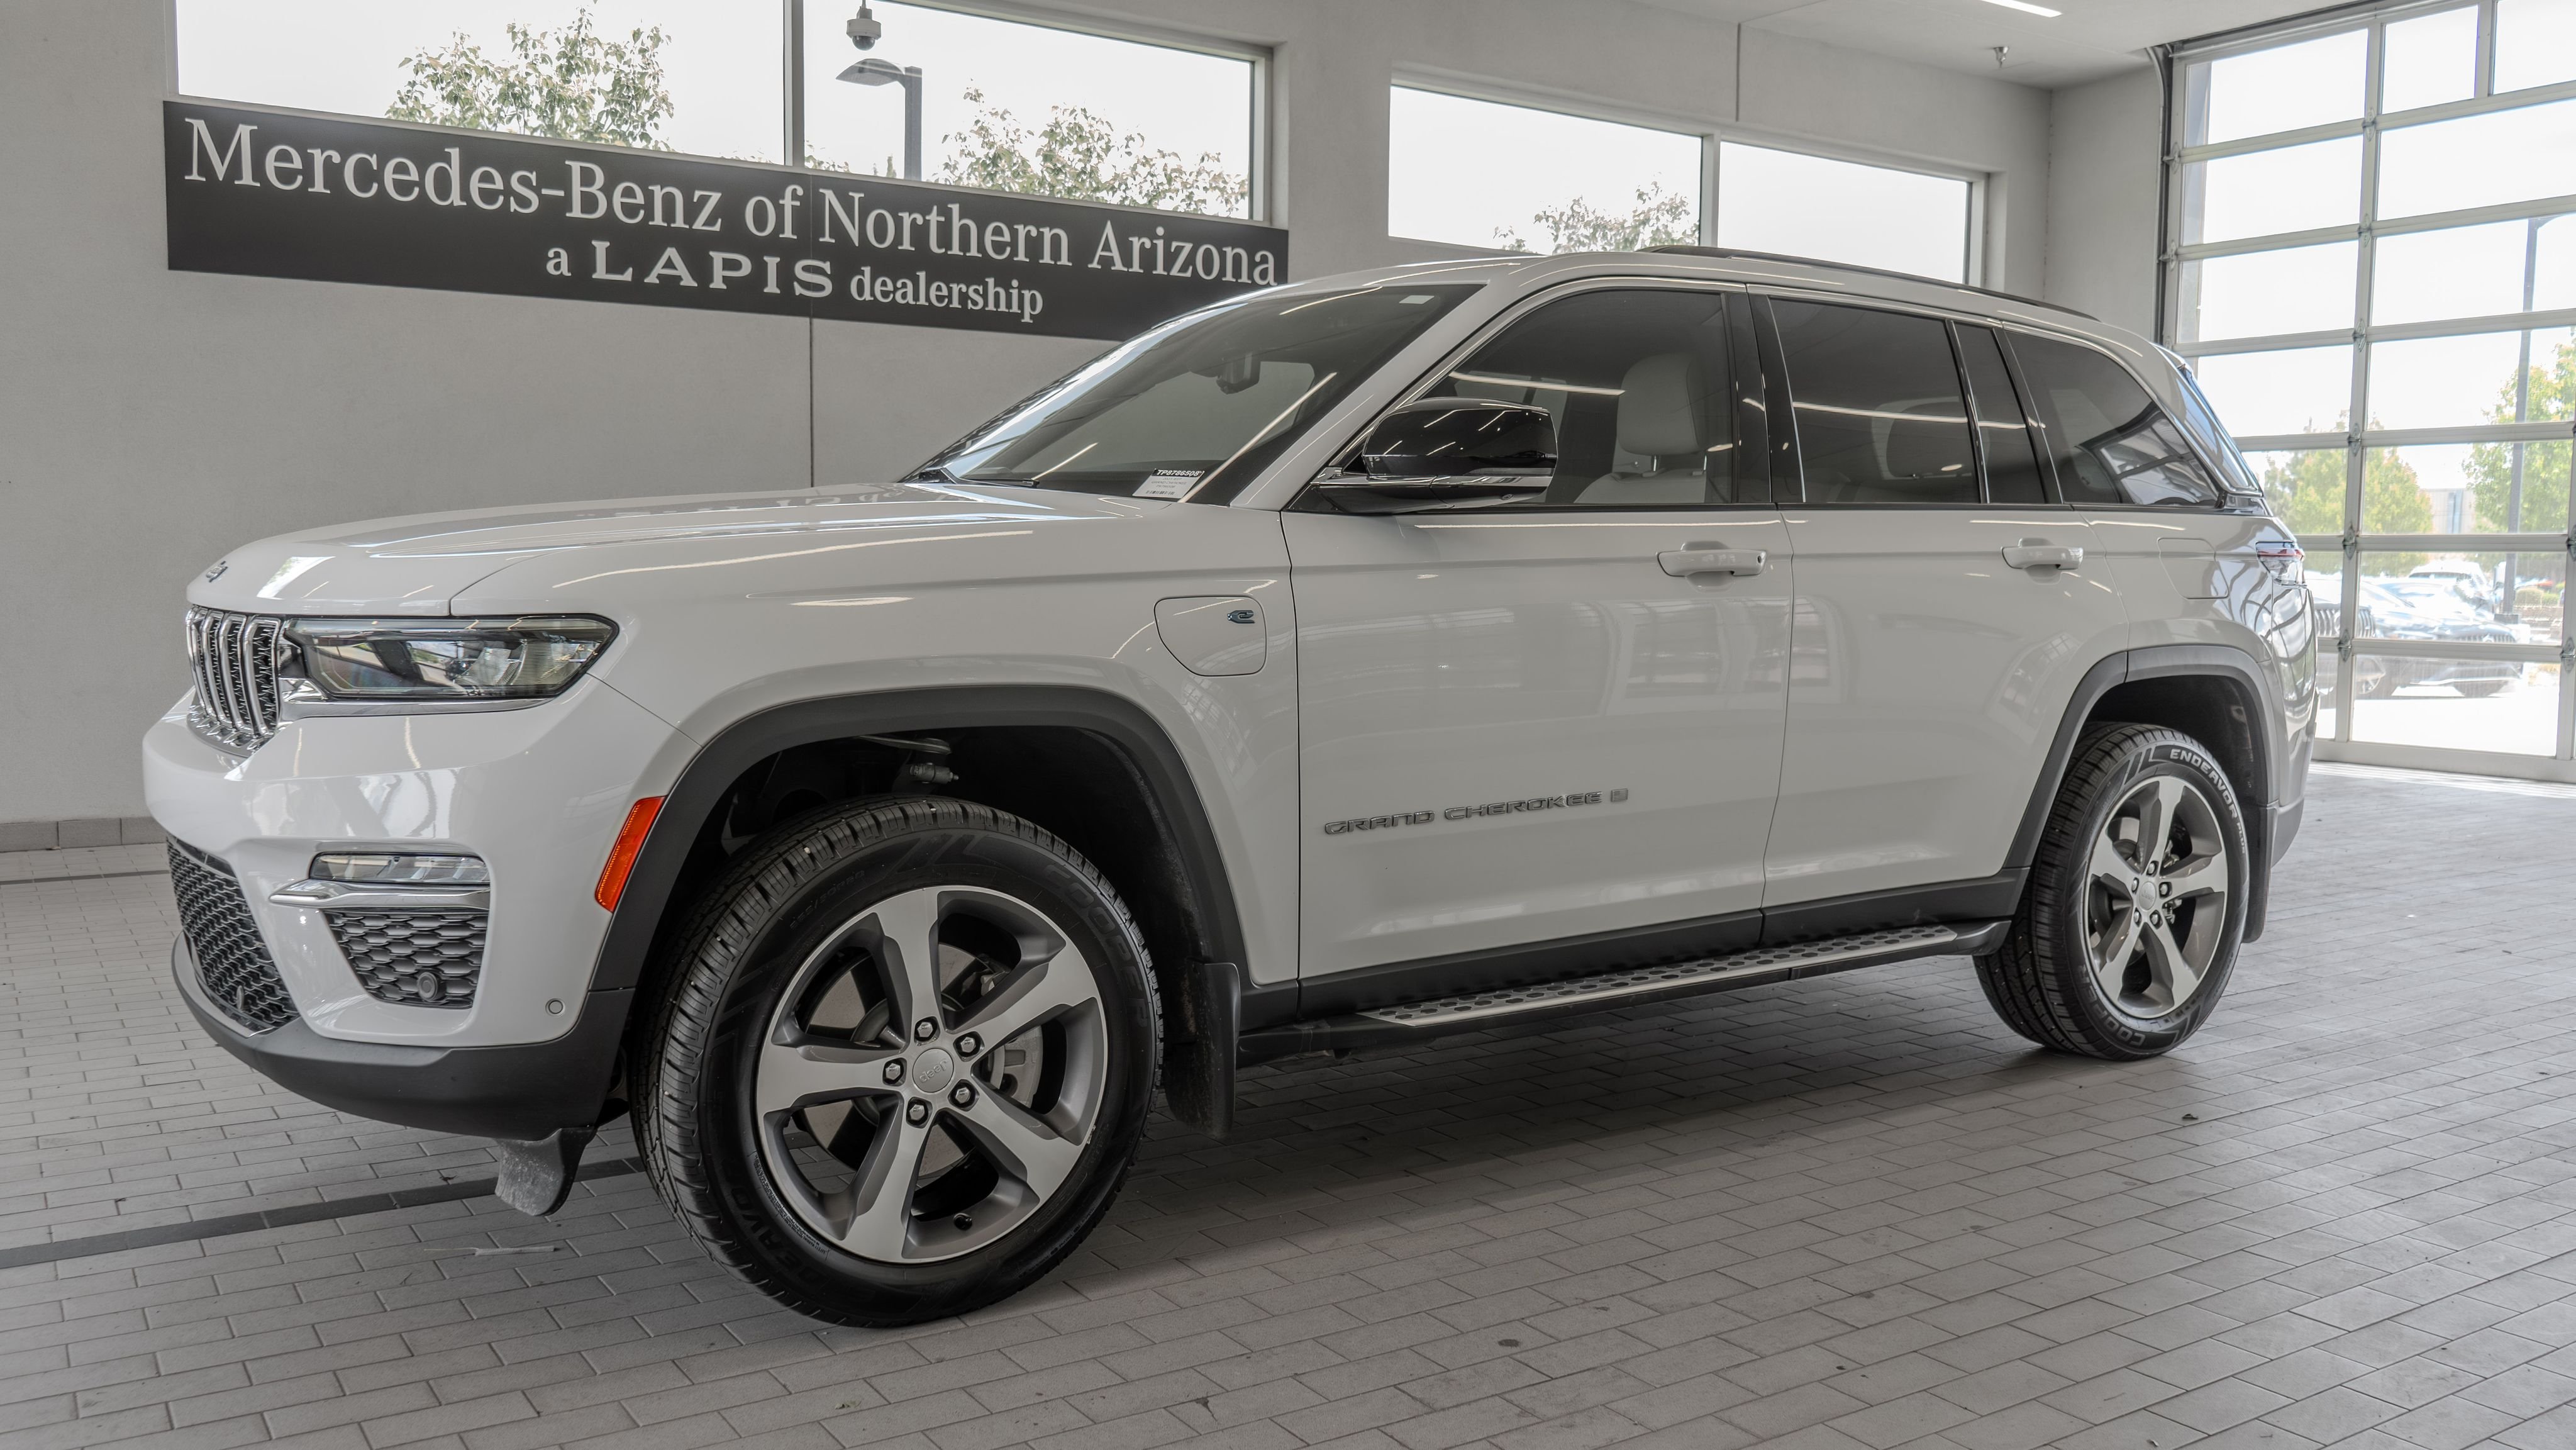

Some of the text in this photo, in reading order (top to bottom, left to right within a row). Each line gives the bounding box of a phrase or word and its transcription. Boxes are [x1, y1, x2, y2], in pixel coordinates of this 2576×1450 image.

[184, 118, 1279, 287] Mercedes-Benz of Northern Arizona
[546, 239, 1044, 323] a LAPIS dealership
[1324, 791, 1604, 835] GRAND CHEROKEE
[2170, 749, 2238, 818] ENDEAVOR
[1043, 864, 1150, 1029] COOPER
[2076, 963, 2146, 1047] COOPER
[919, 1057, 948, 1083] Jeep
